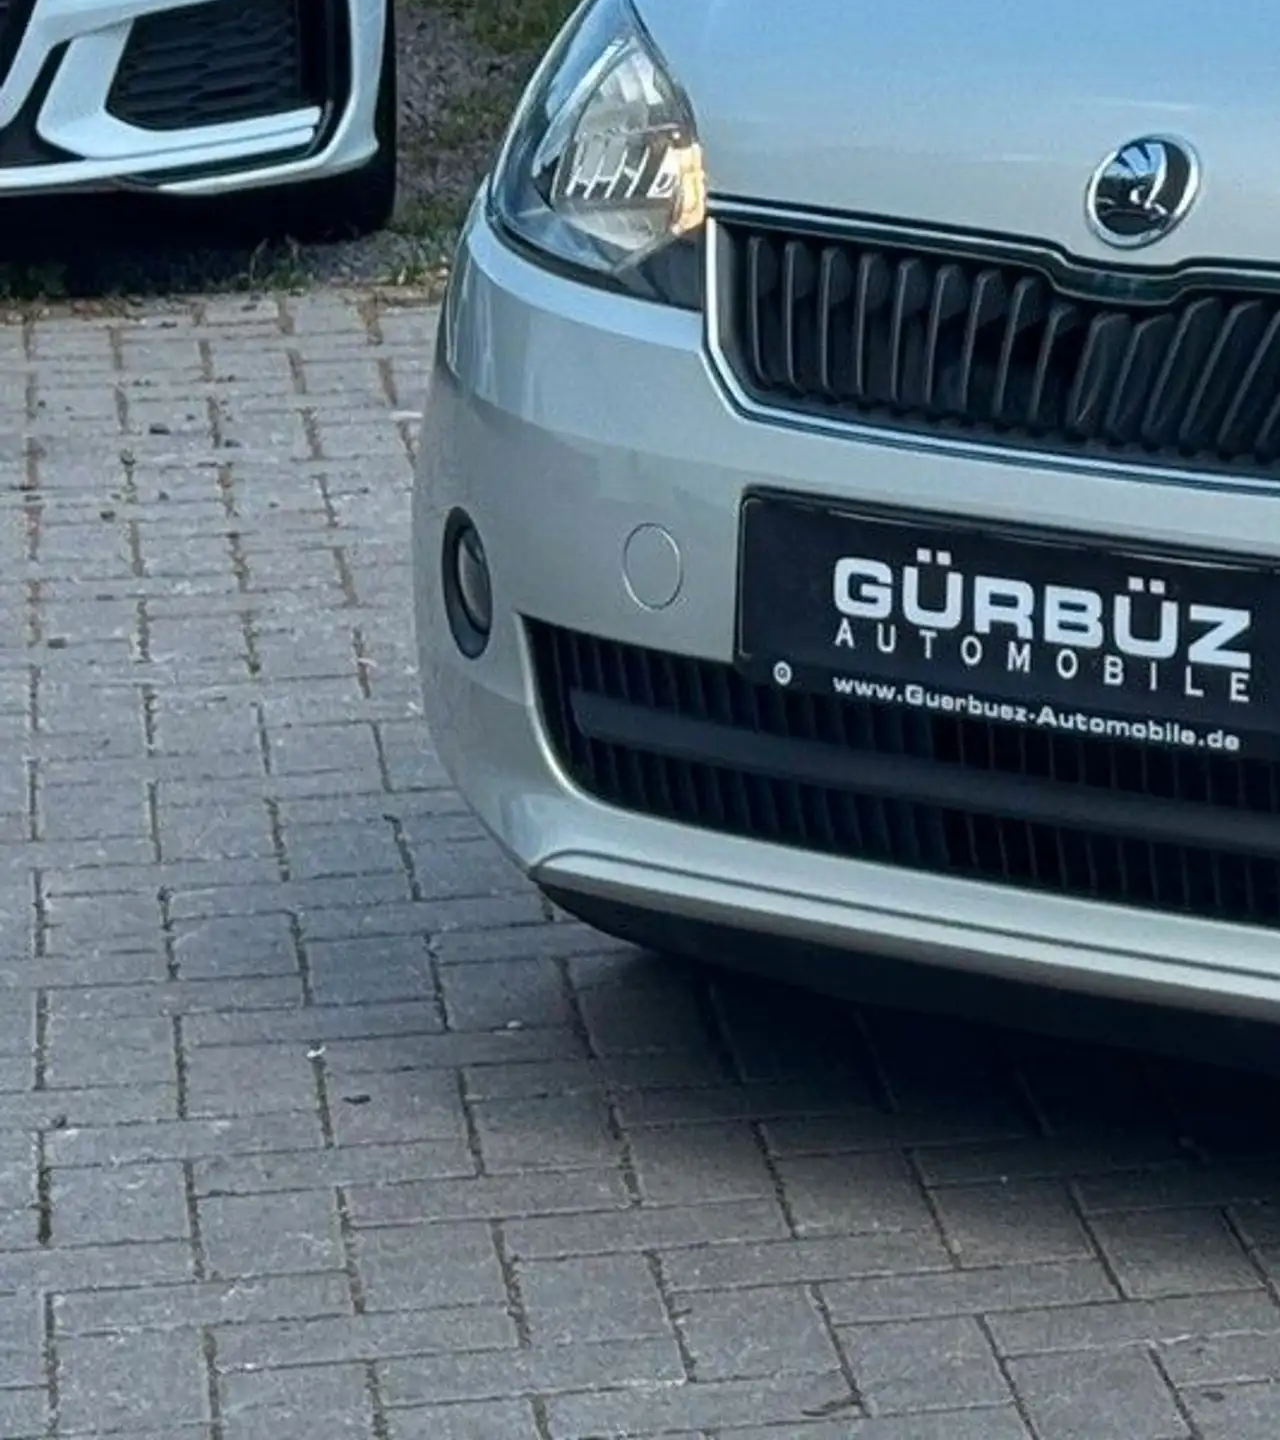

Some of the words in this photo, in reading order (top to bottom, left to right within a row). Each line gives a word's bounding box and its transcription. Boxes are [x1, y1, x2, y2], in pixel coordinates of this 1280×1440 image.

[834, 548, 1251, 668] GÜRBÜZ
[834, 618, 1250, 702] AUTOMOBILE
[833, 675, 1240, 751] www.Guerbuez-Automobile.de
